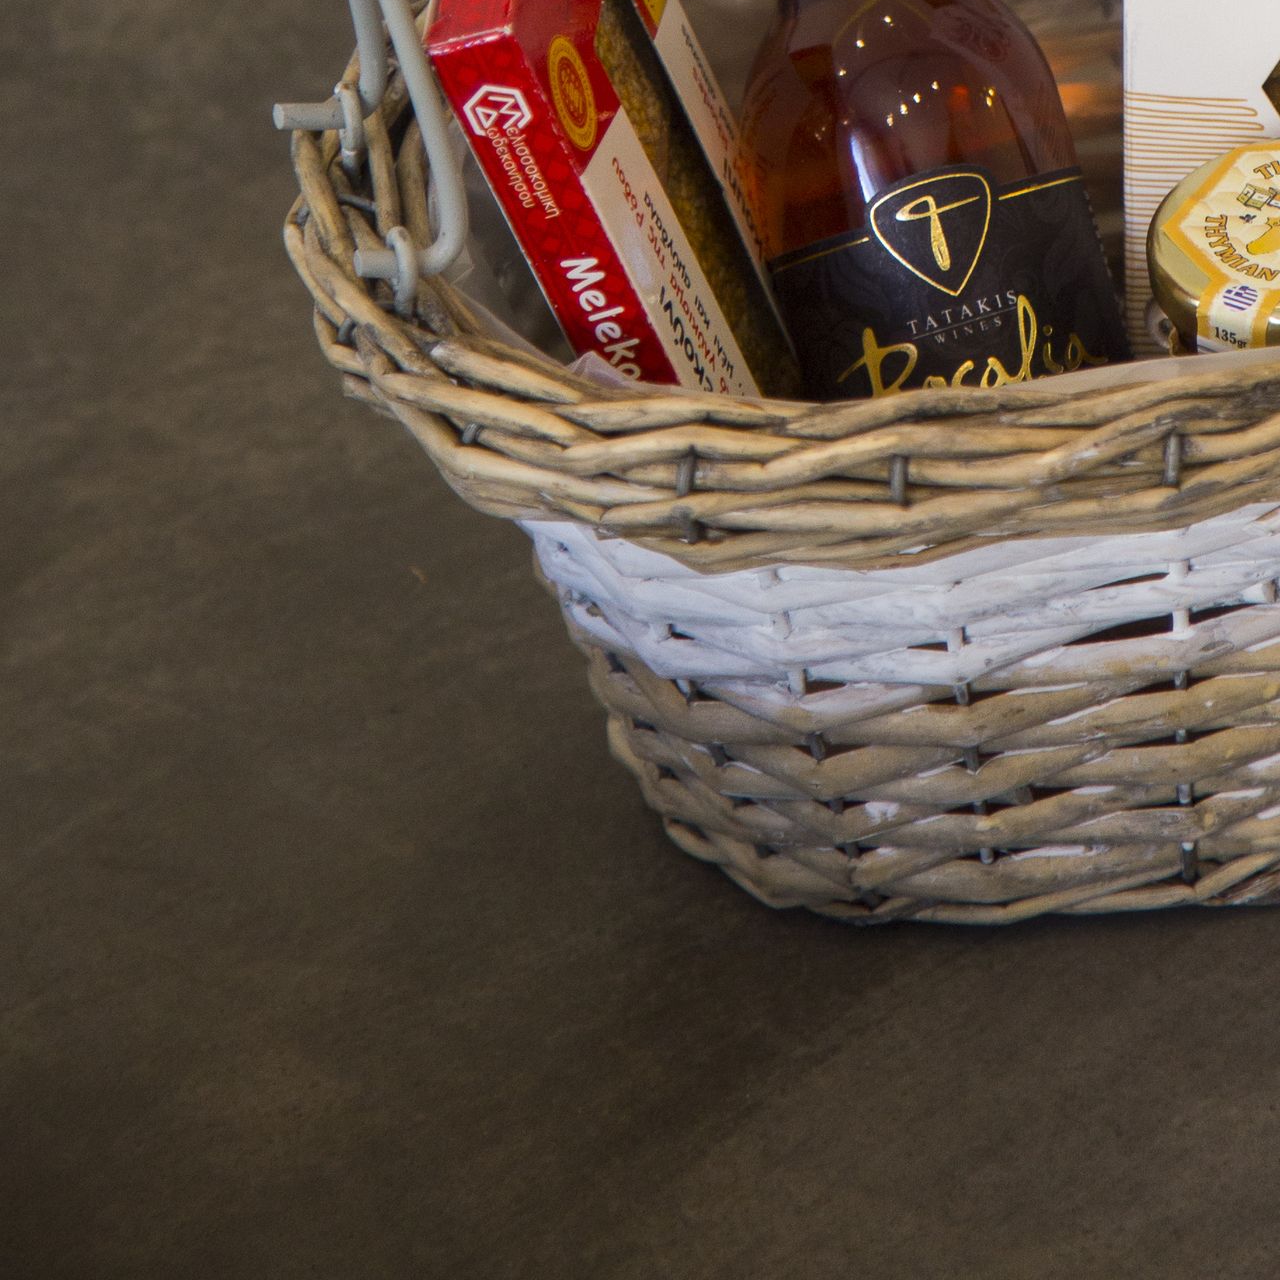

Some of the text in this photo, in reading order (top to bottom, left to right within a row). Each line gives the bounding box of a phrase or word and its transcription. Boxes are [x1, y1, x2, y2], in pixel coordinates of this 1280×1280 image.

[643, 191, 692, 290] αμύγδαλα
[611, 156, 717, 373] γλύκισμα της Ρόδου
[694, 295, 711, 331] και
[906, 289, 1018, 336] TATAKIS
[934, 315, 1003, 345] WINES
[713, 334, 735, 380] μέλι
[1213, 325, 1248, 351] 135gr
